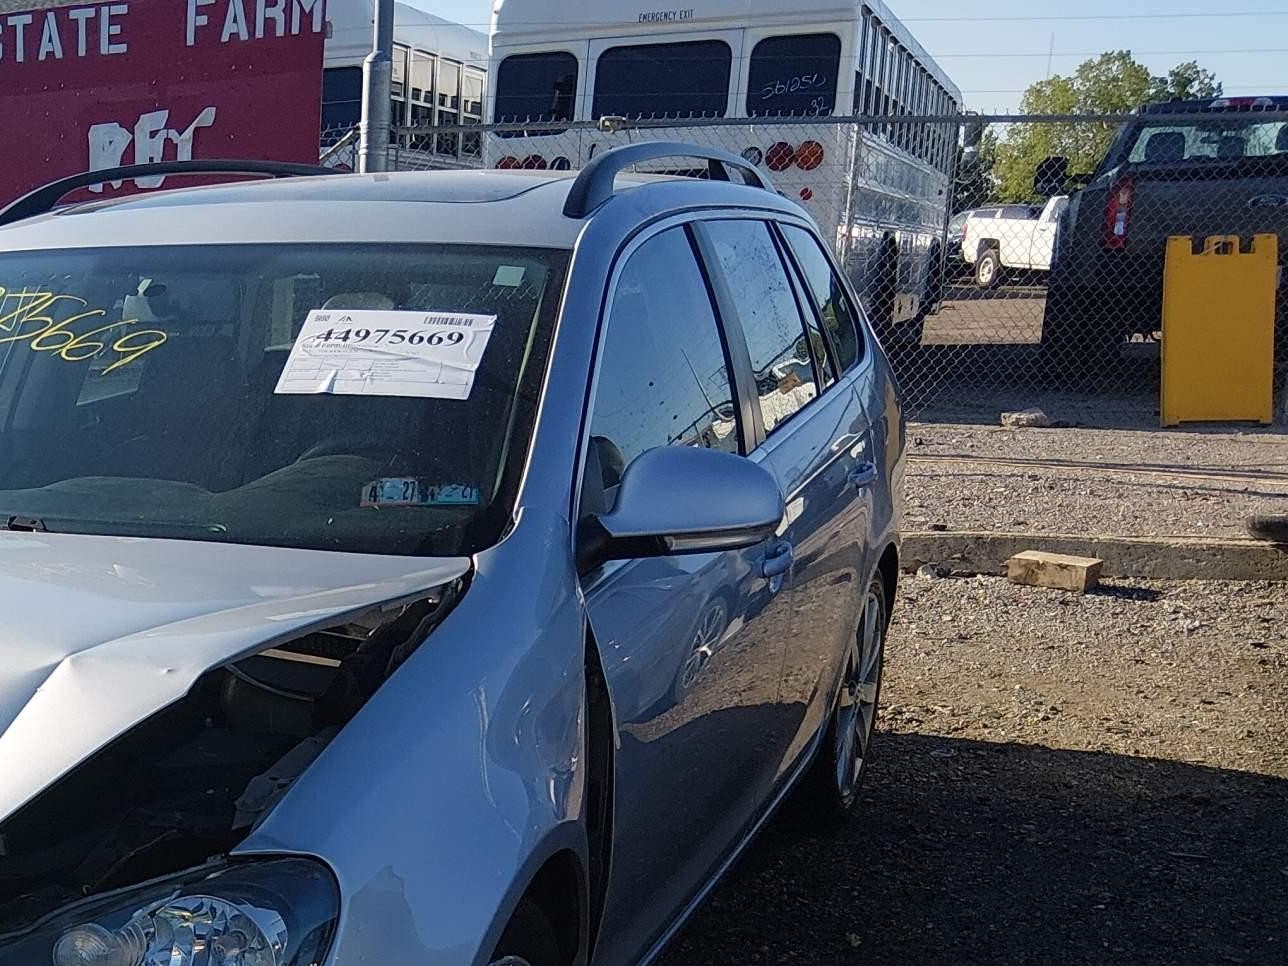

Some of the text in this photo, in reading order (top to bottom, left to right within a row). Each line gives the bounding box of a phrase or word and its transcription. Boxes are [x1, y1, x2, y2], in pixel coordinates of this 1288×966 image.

[185, 0, 323, 47] FARM
[638, 9, 694, 23] EMERGENCY EXIT
[316, 328, 464, 347] 44975669
